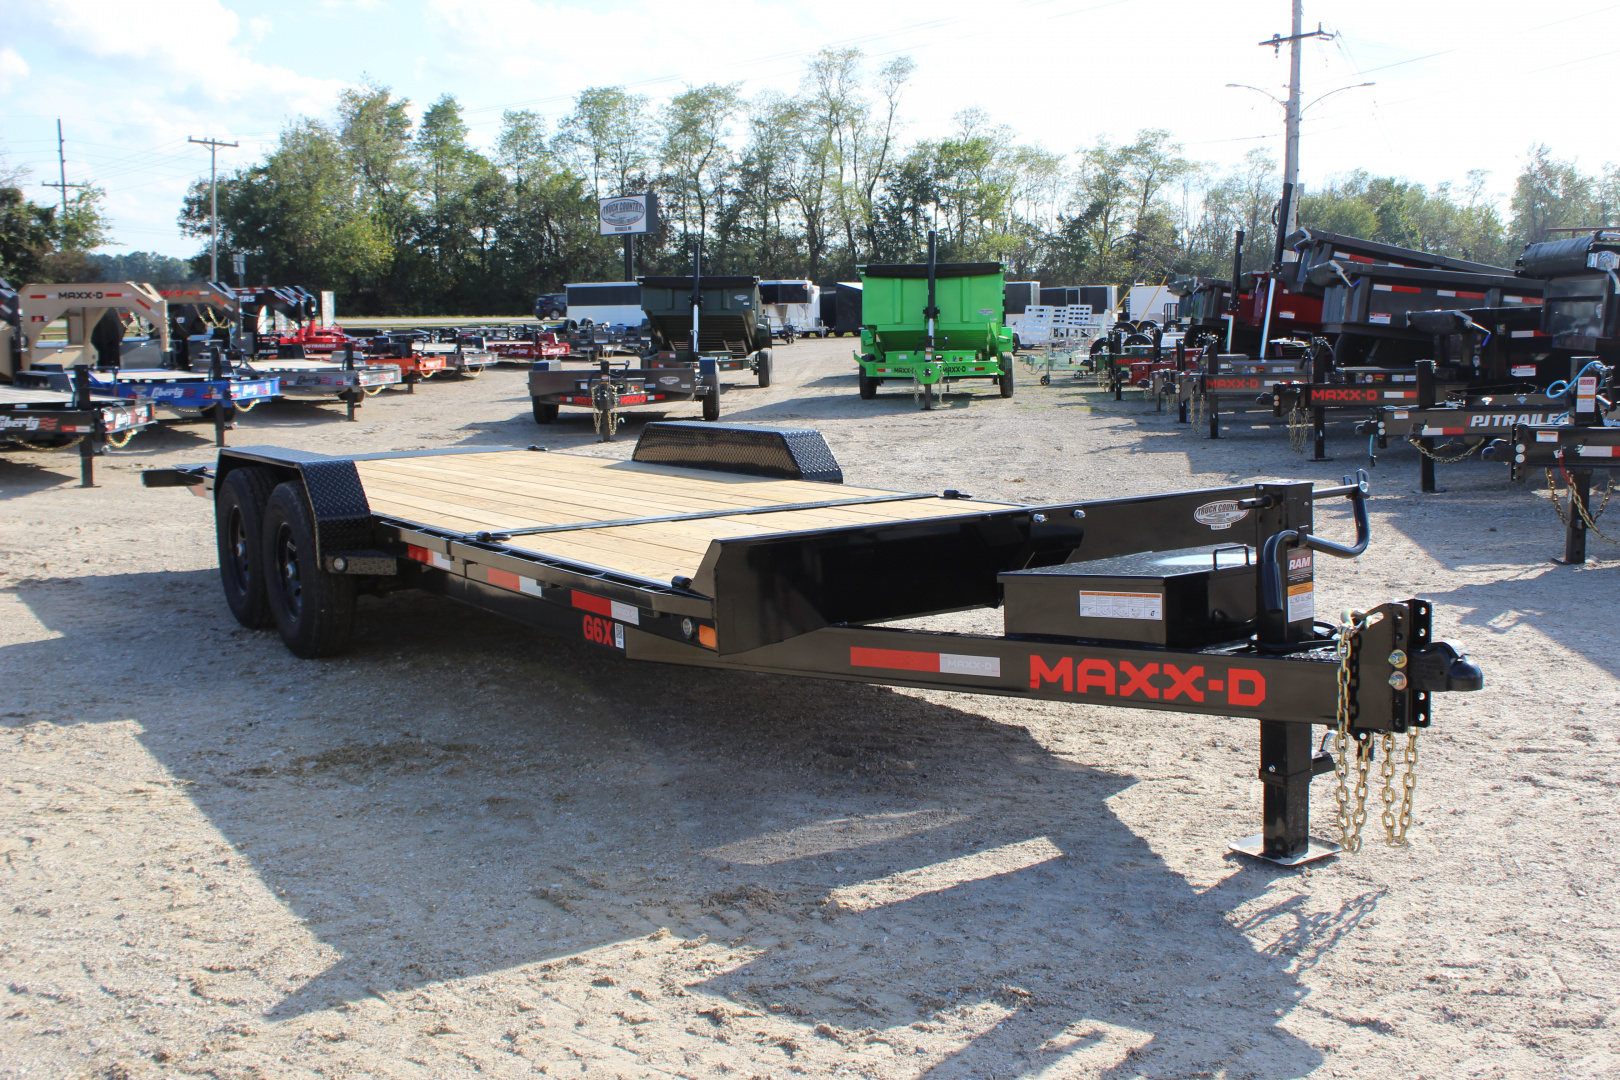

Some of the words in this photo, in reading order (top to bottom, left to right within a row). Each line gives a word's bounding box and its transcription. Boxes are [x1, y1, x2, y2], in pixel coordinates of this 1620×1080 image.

[603, 203, 618, 215] TRUCK
[619, 202, 644, 211] COUNTRY
[58, 291, 103, 299] MAXX-D
[1206, 379, 1258, 389] MAXX-D
[152, 387, 184, 398] Liberty
[1311, 390, 1377, 400] MAXX-D
[620, 395, 647, 405] MAXX-D
[1470, 415, 1491, 427] PJ
[1198, 504, 1218, 516] TRUCK
[1217, 503, 1239, 513] COUNT
[1288, 556, 1311, 570] RAM
[583, 614, 614, 647] G6X
[946, 659, 992, 670] MAXX-D
[1029, 654, 1266, 707] MAXX-D
